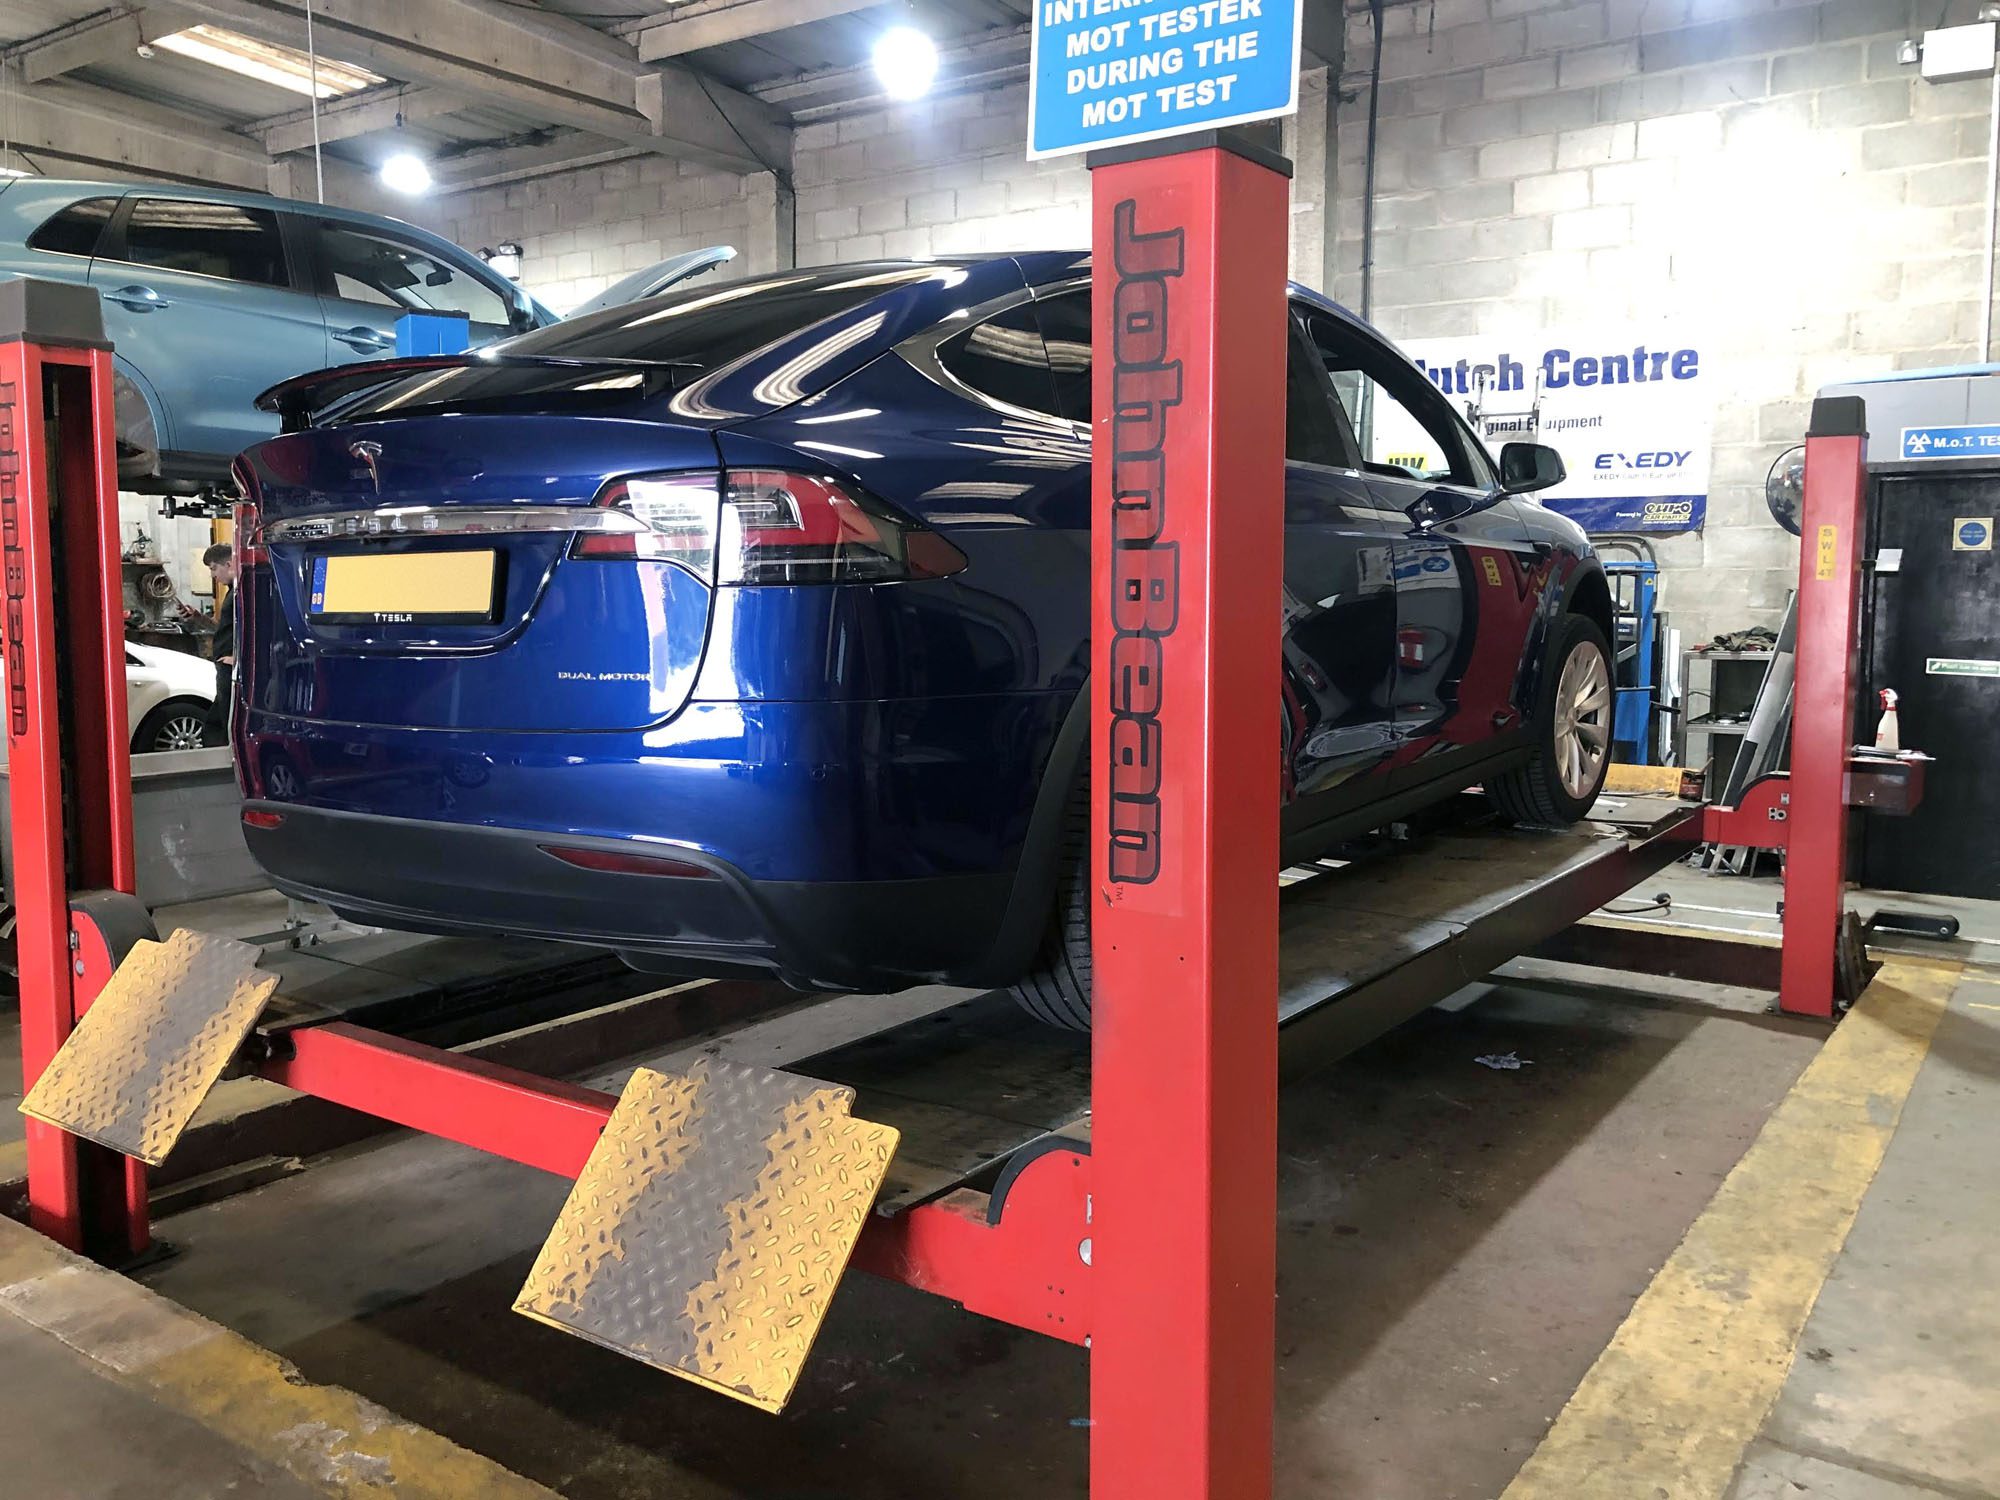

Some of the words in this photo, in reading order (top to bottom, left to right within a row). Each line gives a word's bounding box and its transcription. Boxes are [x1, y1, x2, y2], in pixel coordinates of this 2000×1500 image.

[1044, 0, 1154, 27] INTER
[1066, 21, 1130, 58] MOT
[1139, 0, 1262, 41] TESTER
[1067, 48, 1183, 95] DURING
[1193, 31, 1258, 67] THE
[1082, 92, 1147, 128] MOT
[1156, 75, 1237, 112] TEST
[1415, 353, 1524, 395] utch
[1543, 346, 1699, 388] Centre
[1486, 418, 1522, 435] ginal
[1527, 415, 1603, 433] Euipment
[1595, 450, 1693, 469] EXEDY
[1108, 199, 1185, 885] JohnBean
[382, 613, 412, 622] TESLA
[558, 671, 596, 681] DUAL
